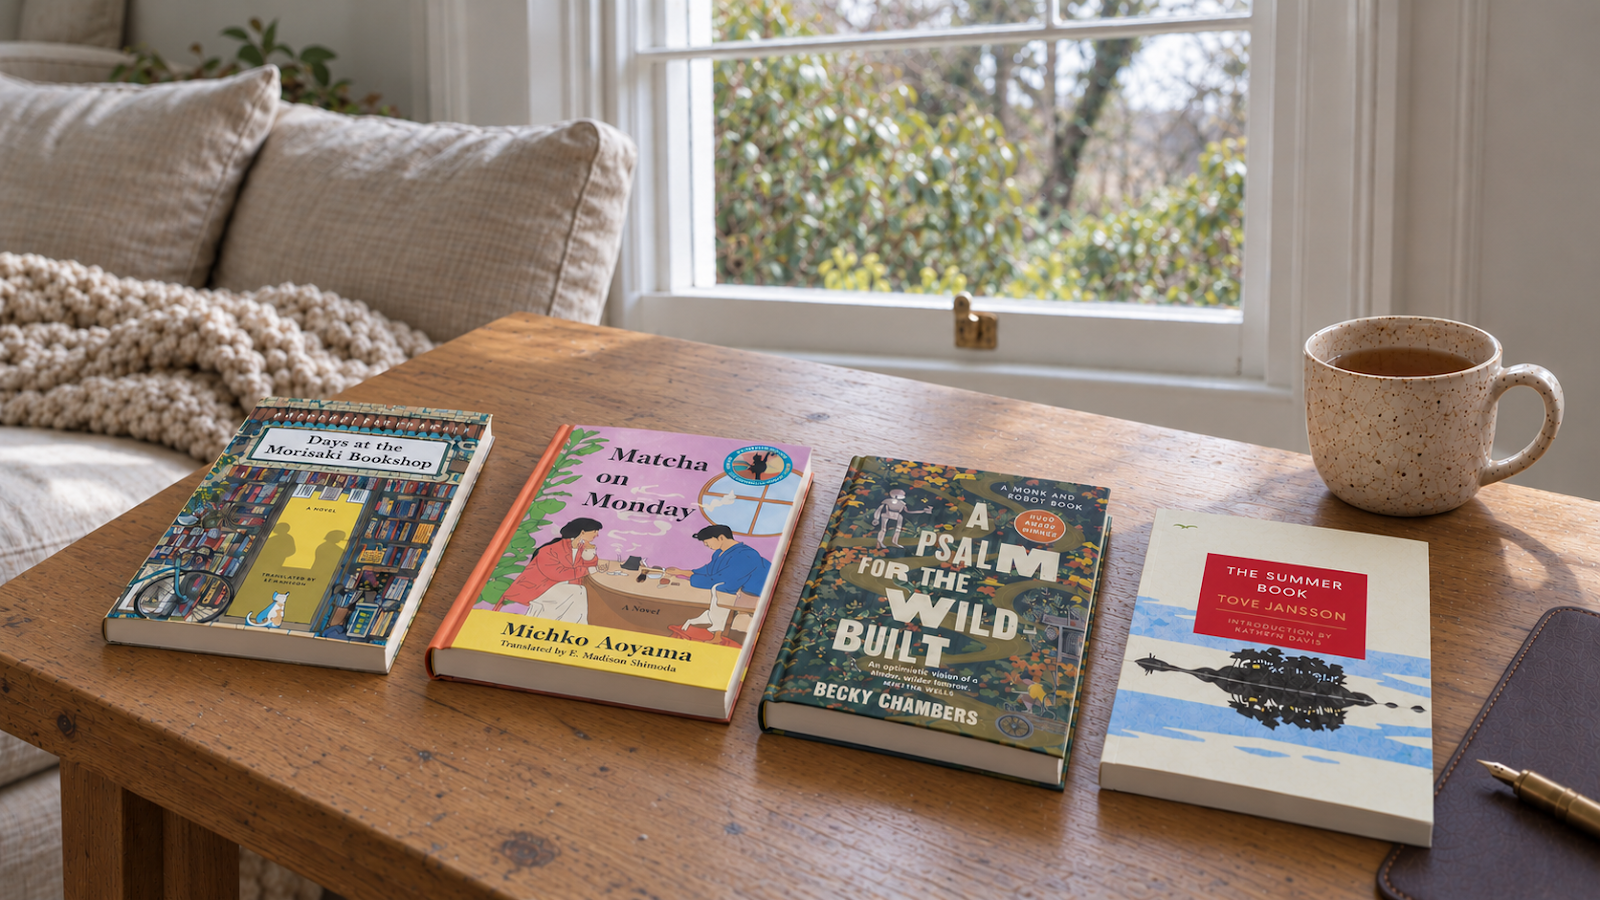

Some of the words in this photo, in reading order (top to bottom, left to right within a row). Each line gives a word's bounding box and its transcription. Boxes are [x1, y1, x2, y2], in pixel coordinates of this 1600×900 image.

[307, 435, 348, 450] Days
[354, 439, 370, 449] at
[376, 442, 403, 453] the
[264, 444, 341, 460] Morisaki
[347, 452, 432, 470] Bookshop
[608, 447, 708, 472] Matcha
[596, 473, 629, 486] on
[1007, 493, 1046, 504] ROBOT
[1050, 500, 1083, 511] BOOK
[1012, 486, 1047, 497] MONK
[1051, 493, 1075, 501] AND
[582, 492, 696, 522] Monday
[966, 502, 989, 531] A
[915, 530, 1060, 582] PSALM
[857, 556, 909, 582] FOR
[921, 566, 971, 594] THE
[1227, 566, 1258, 579] THE
[1266, 571, 1342, 591] SUMMER
[1257, 583, 1308, 599] BOOK
[631, 604, 661, 615] Novel
[1217, 593, 1260, 609] TOVE
[1265, 601, 1346, 622] JANSSON
[1228, 618, 1314, 637] INTRODUCTION
[500, 621, 589, 647] Michko
[594, 635, 692, 662] Aoyama
[832, 618, 950, 668] BUILT
[500, 639, 552, 654] Translated
[555, 647, 568, 658] by
[569, 649, 579, 658] E.
[582, 651, 627, 665] Madison
[630, 658, 677, 673] Shimoda
[868, 660, 881, 669] An
[960, 675, 971, 683] of
[813, 681, 874, 705] BECKY
[878, 692, 979, 726] CHAMBERS
